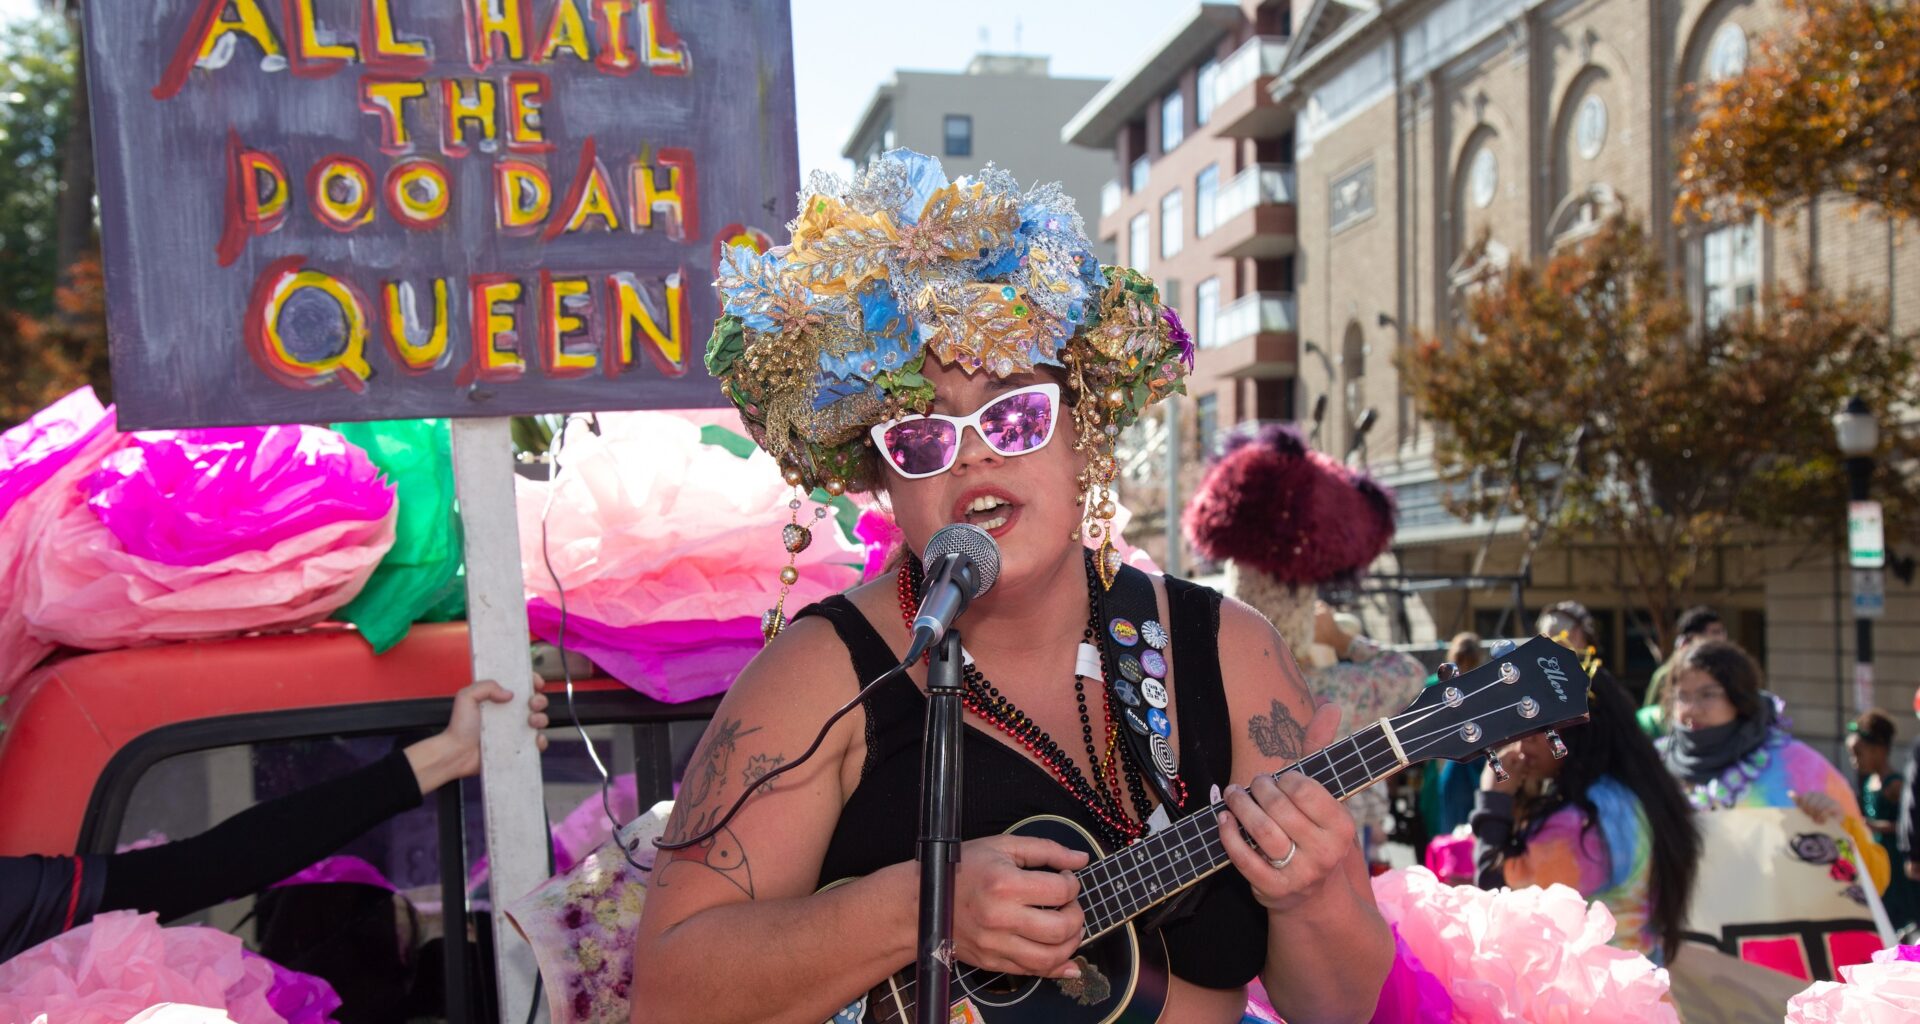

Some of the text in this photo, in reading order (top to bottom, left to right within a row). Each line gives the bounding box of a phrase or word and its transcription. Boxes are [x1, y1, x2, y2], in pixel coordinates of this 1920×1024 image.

[155, 0, 692, 82] ALL HAIL
[358, 72, 556, 157] THE
[220, 136, 698, 250] DOO DAH
[246, 256, 692, 393] QUEEN
[1127, 708, 1149, 731] knob
[1537, 656, 1569, 703] Ellen
